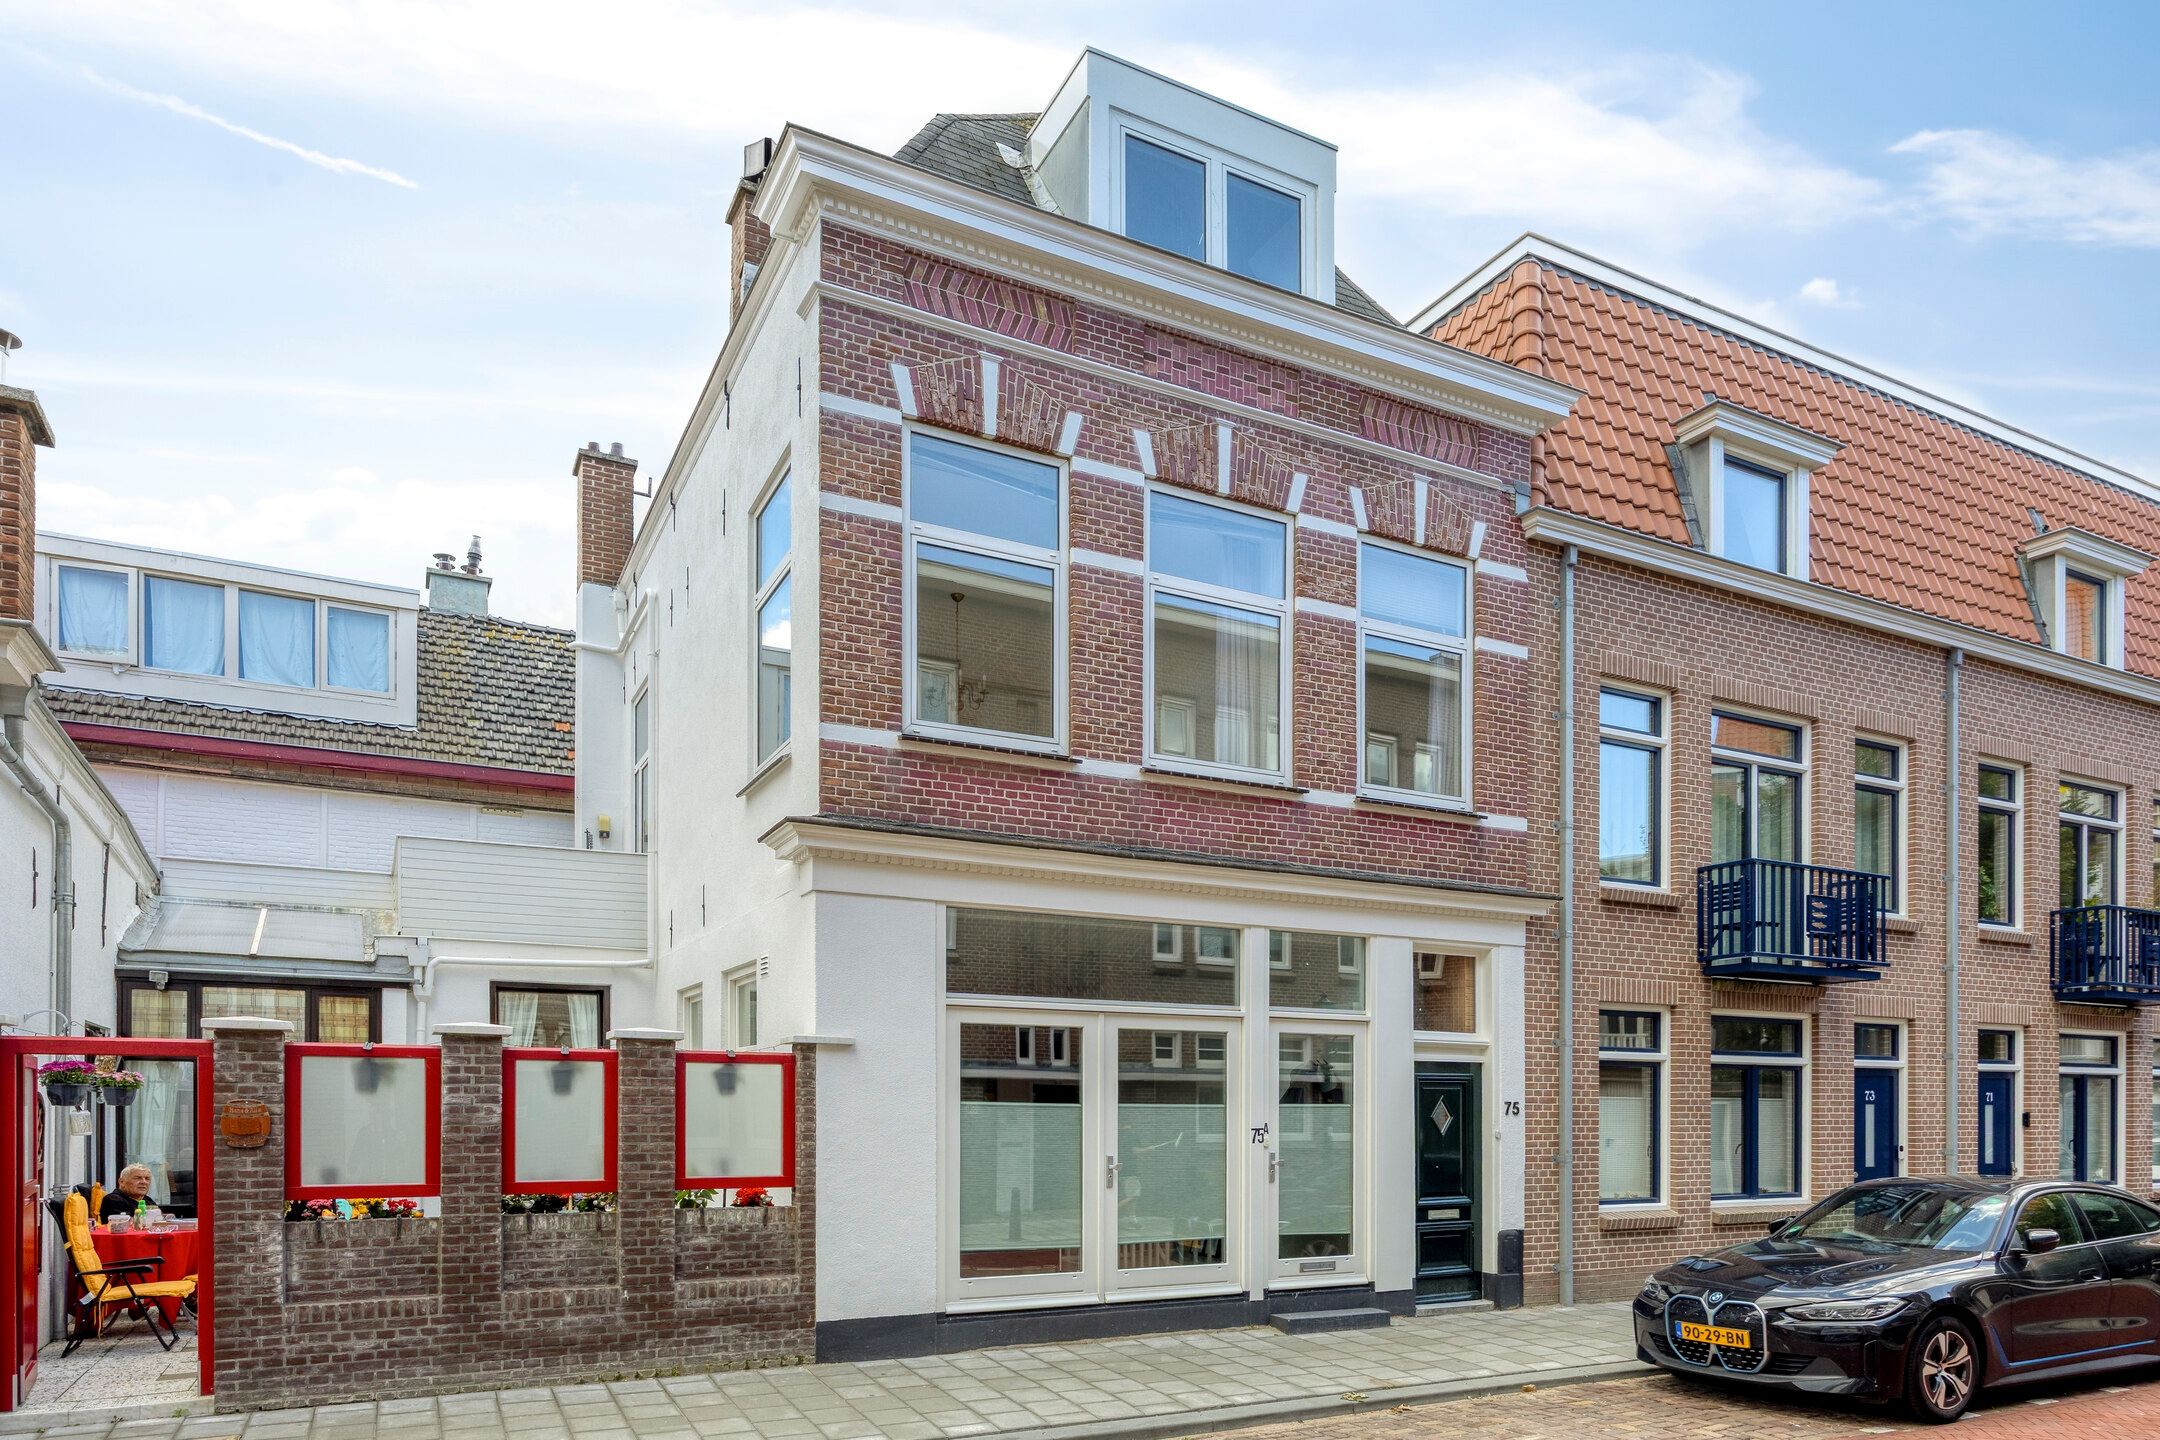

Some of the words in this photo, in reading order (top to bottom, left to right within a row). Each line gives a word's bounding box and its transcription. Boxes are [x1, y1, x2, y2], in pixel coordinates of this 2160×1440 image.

[1864, 1090, 1875, 1101] 73
[1985, 1092, 1994, 1102] 71
[1504, 1101, 1520, 1116] 75
[1683, 1325, 1745, 1346] 90-29-BN
